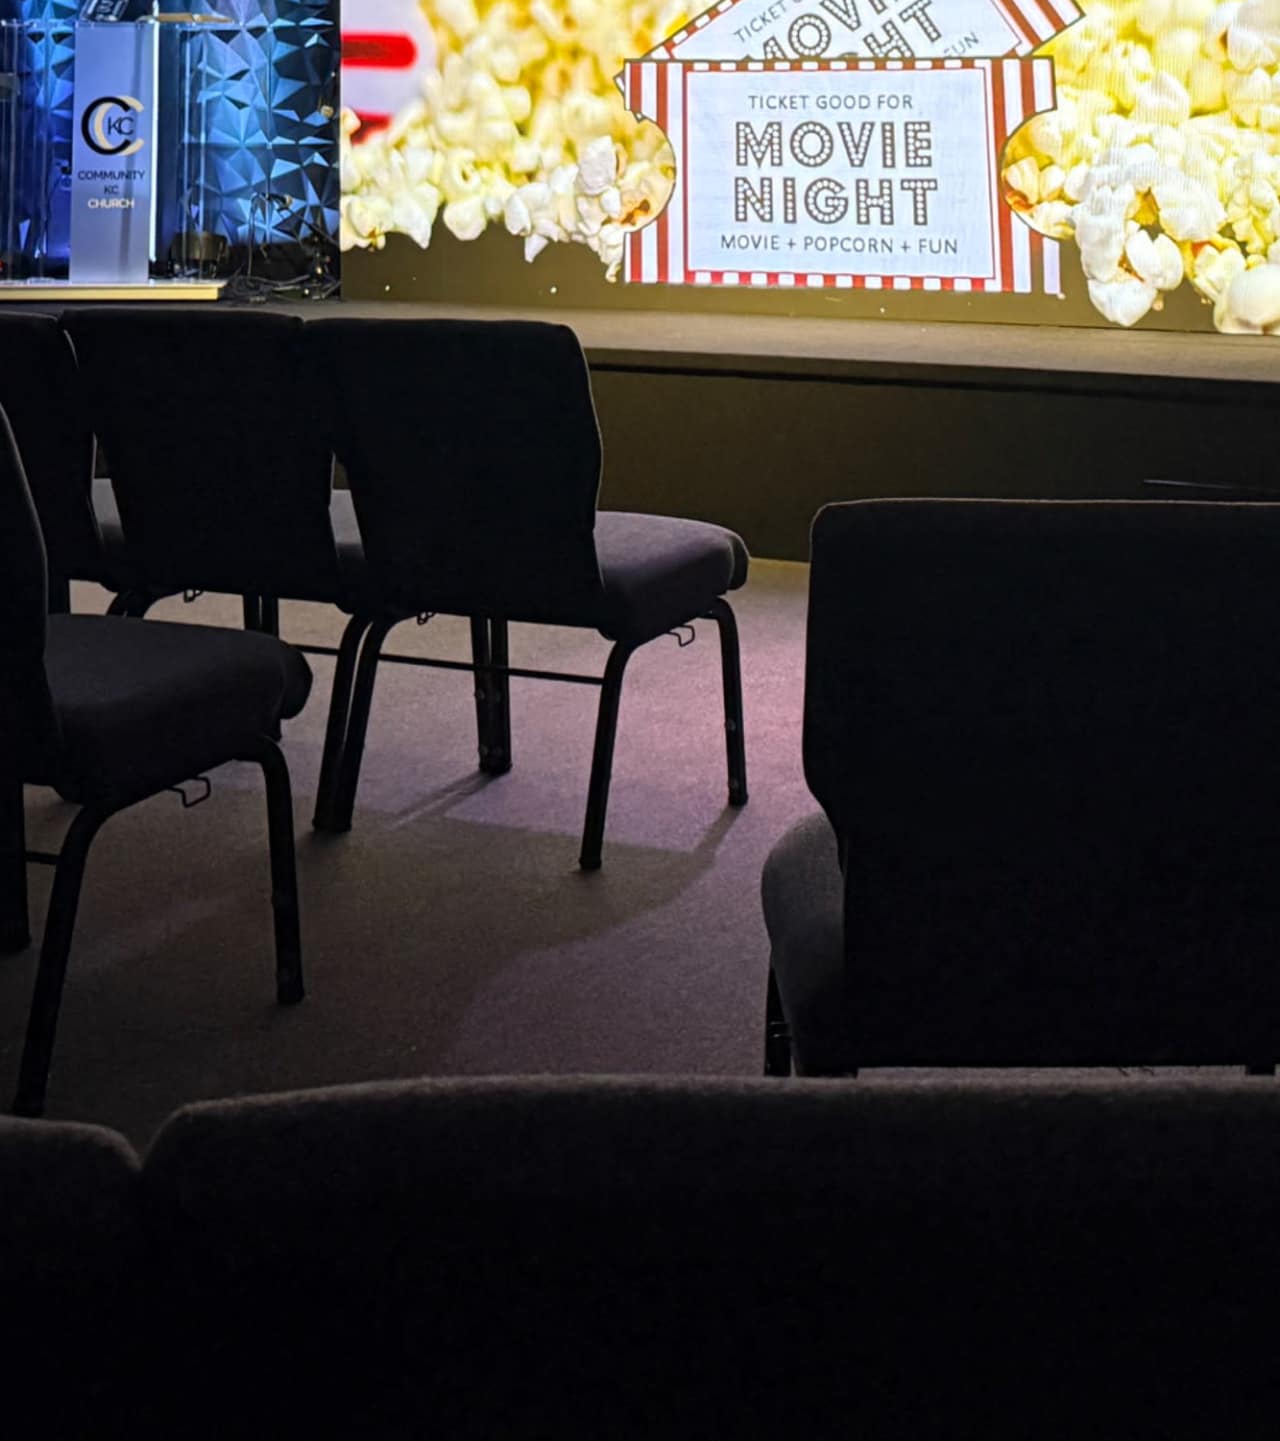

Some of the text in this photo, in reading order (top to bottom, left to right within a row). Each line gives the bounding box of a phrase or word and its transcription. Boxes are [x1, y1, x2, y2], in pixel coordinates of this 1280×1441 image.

[748, 94, 913, 110] TICKET GOOD FOR
[735, 120, 933, 168] MOVIE
[77, 170, 145, 181] COMMUNITY
[104, 185, 119, 195] KC
[87, 198, 135, 209] CHURCH
[734, 176, 939, 227] NIGHT
[720, 234, 780, 252] MOVIE
[803, 235, 894, 254] POPCORN
[918, 238, 959, 255] FUN
